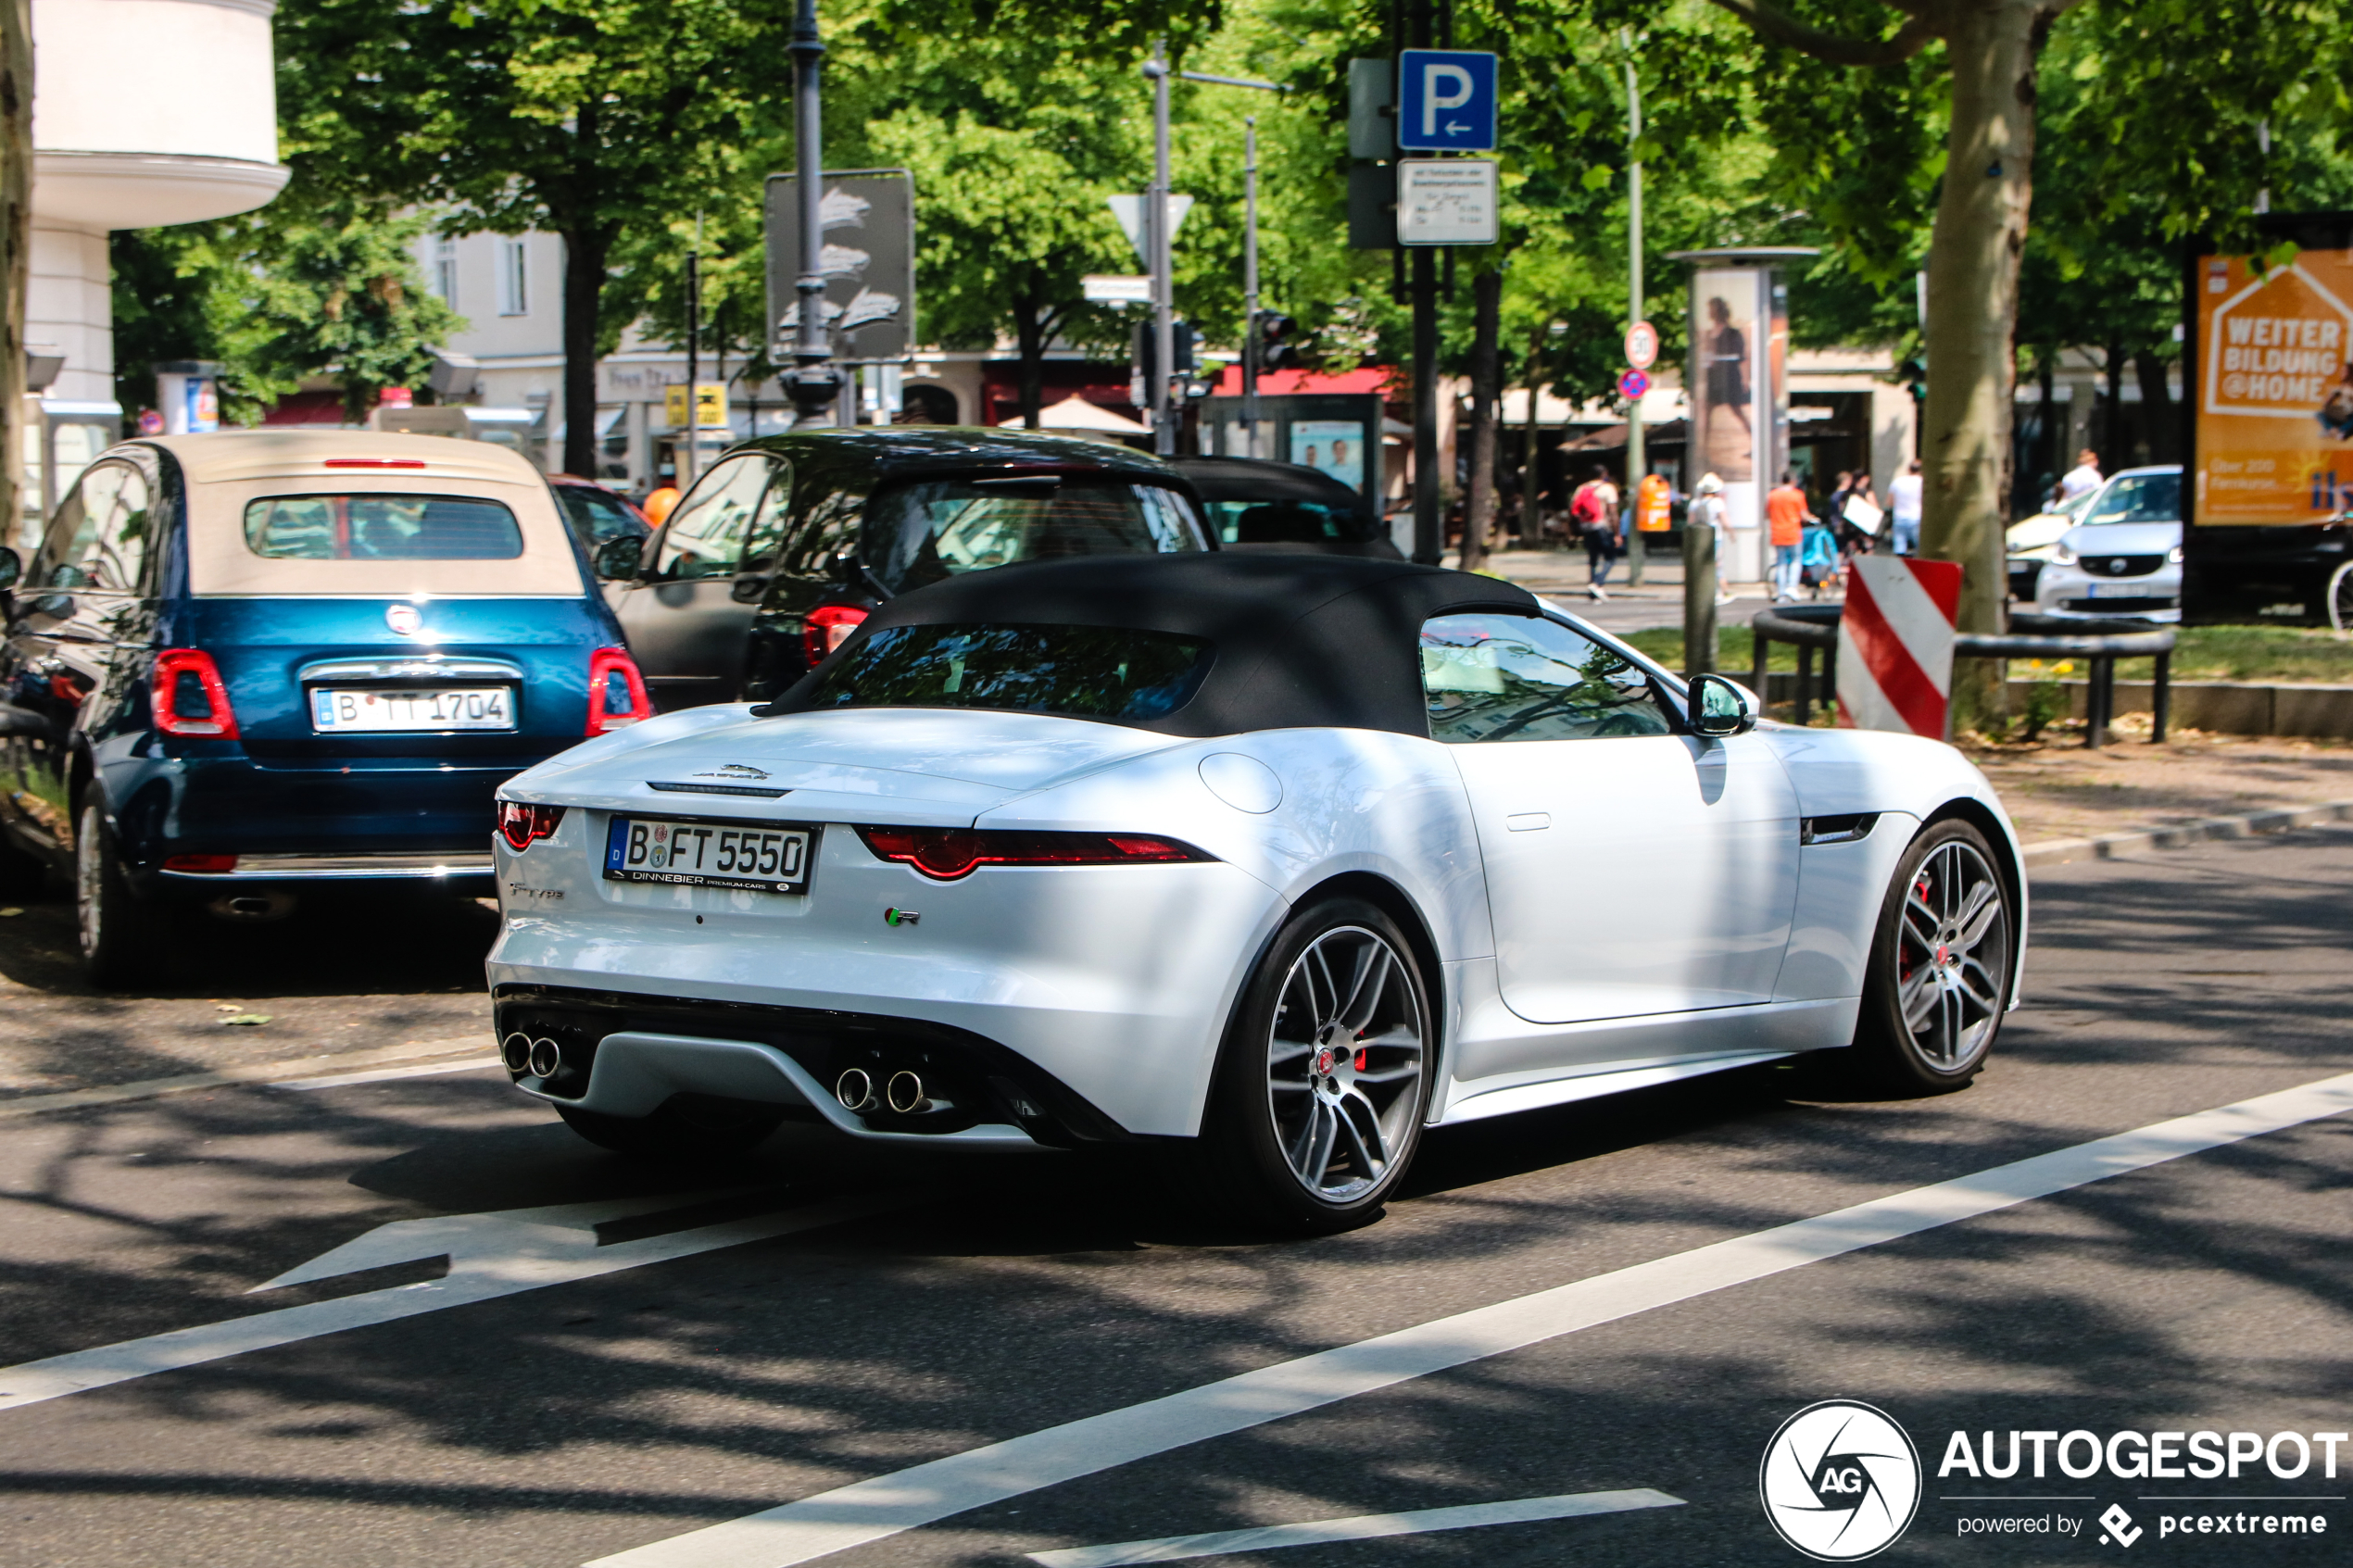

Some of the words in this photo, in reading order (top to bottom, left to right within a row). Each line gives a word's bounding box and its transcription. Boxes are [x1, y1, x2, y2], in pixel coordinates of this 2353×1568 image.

[1422, 63, 1474, 136] P
[1634, 334, 1650, 355] 30
[2228, 318, 2341, 348] WEITER
[2223, 346, 2337, 375] BILDUNG
[2222, 372, 2325, 402] @HOME
[339, 695, 358, 721] B
[381, 693, 417, 721] TT
[429, 694, 503, 721] 1704
[627, 824, 649, 865] B
[668, 828, 713, 870] FT
[716, 831, 803, 877] 5550
[633, 872, 705, 884] DINNEBIER
